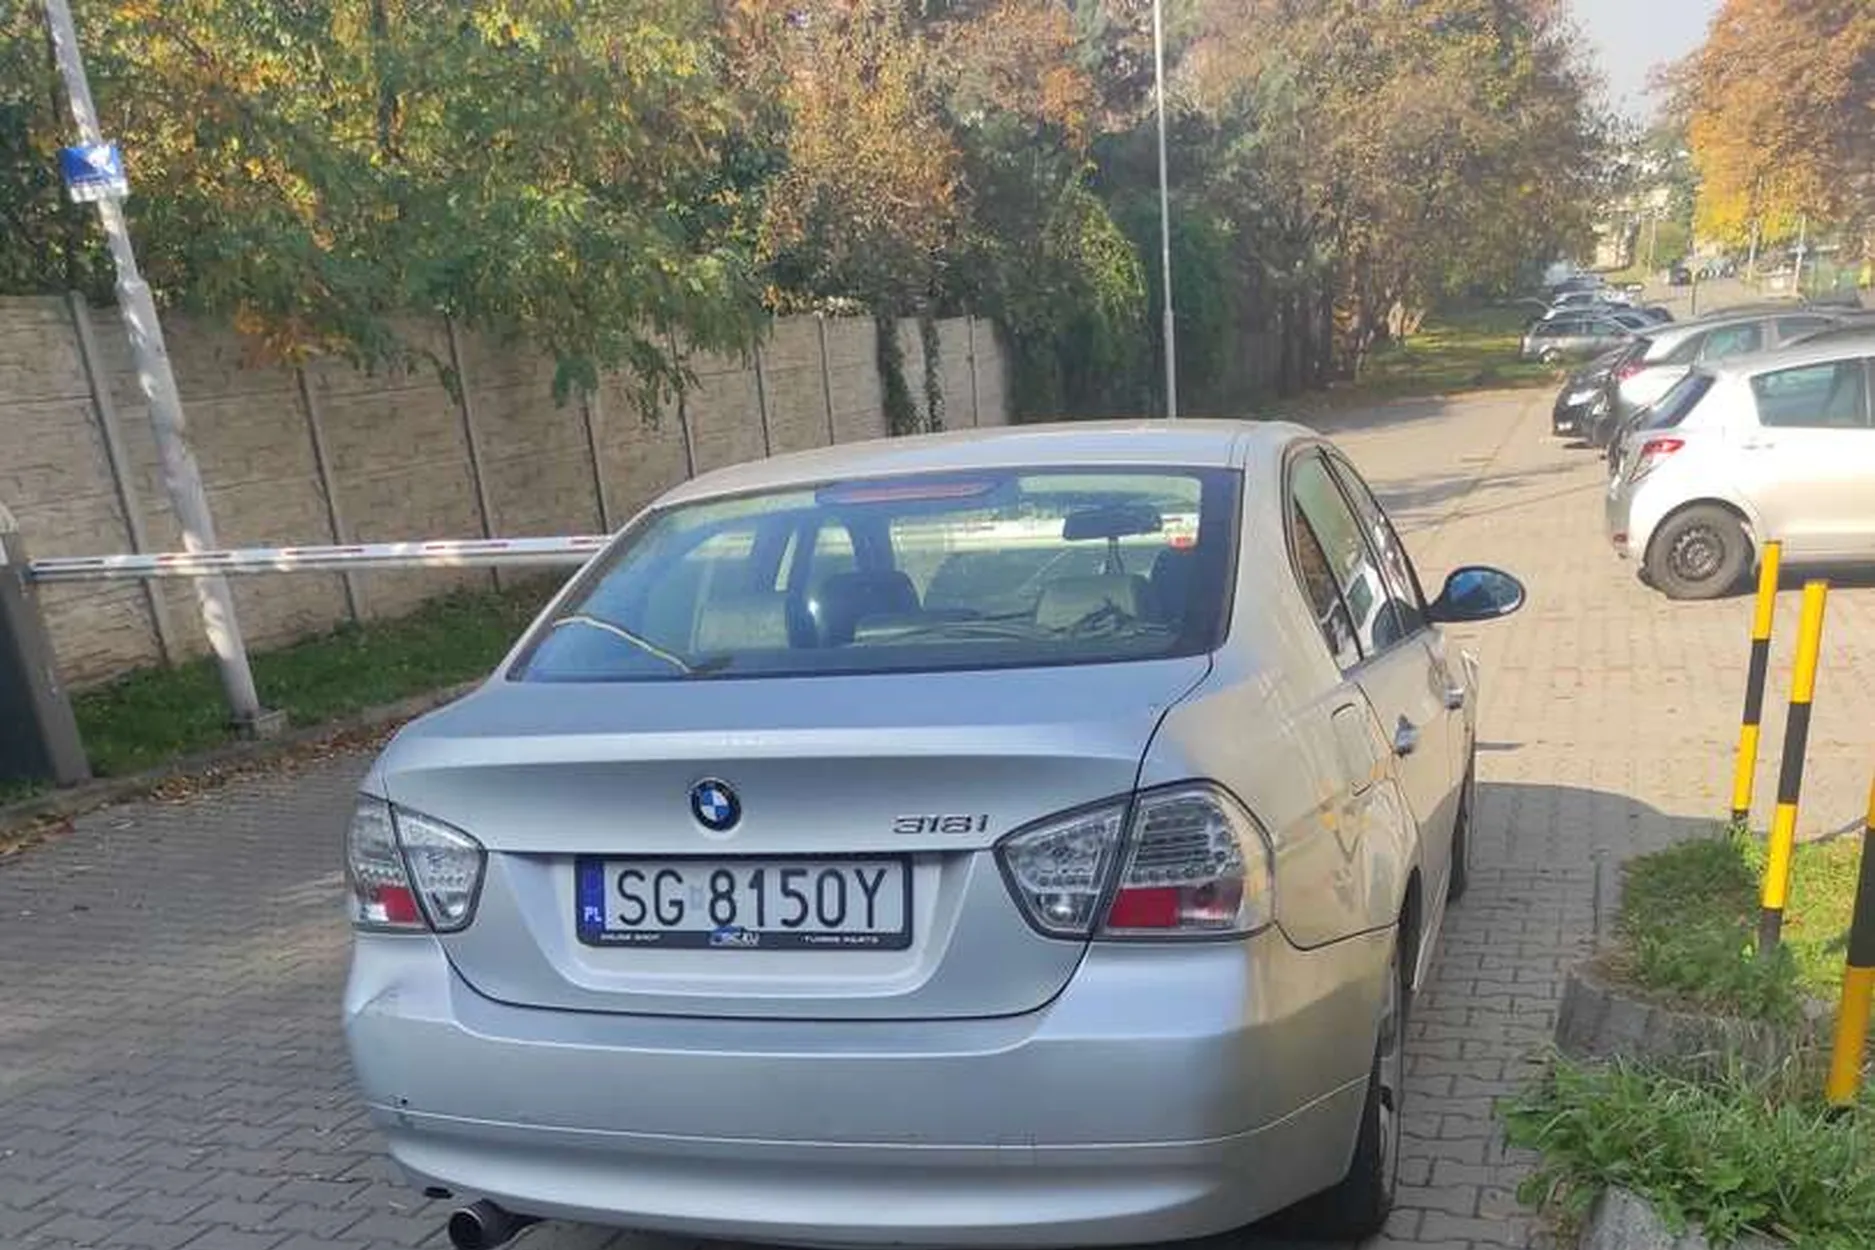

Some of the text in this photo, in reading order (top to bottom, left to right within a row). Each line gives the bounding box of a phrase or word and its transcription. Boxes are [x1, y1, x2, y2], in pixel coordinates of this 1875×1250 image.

[893, 813, 989, 834] 318i
[617, 868, 887, 928] SG 8150Y
[584, 906, 603, 923] PL
